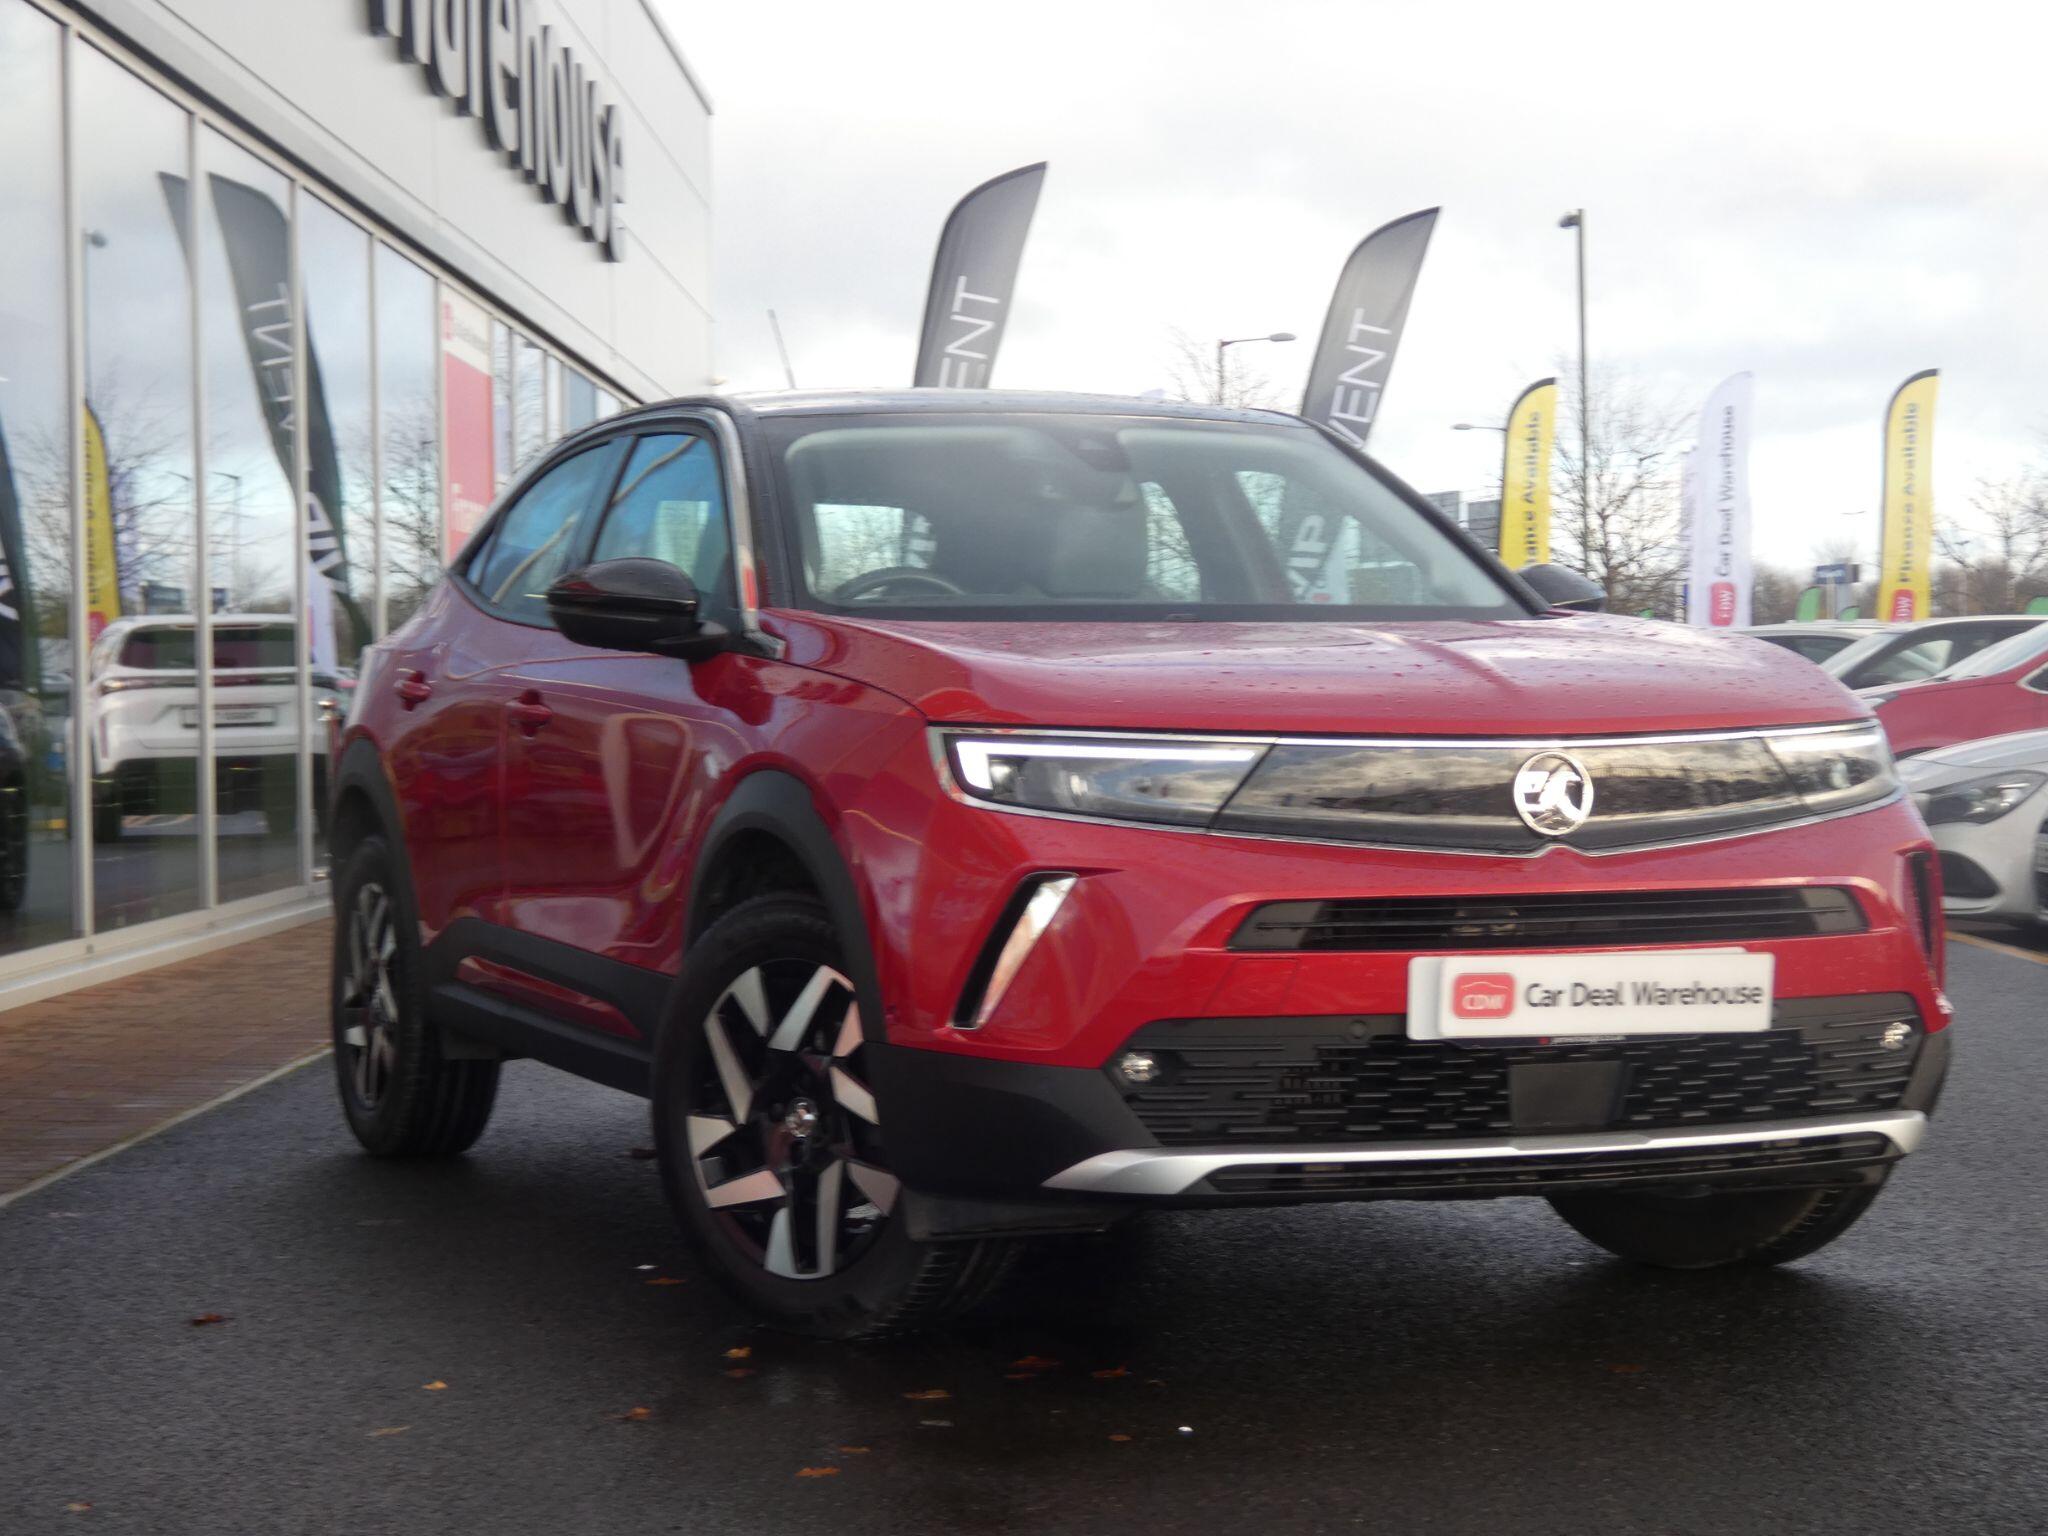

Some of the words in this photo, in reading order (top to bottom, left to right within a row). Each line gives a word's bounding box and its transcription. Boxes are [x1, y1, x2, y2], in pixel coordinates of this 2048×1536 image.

[366, 0, 626, 263] arehouse
[1522, 411, 1541, 504] Available
[1718, 405, 1735, 503] Warehouse
[1902, 403, 1919, 496] Available
[1716, 551, 1732, 577] Car
[1718, 509, 1734, 546] Deal
[1899, 503, 1914, 583] Finance
[1525, 982, 1563, 1008] Car
[1570, 981, 1623, 1008] Deal
[1631, 980, 1764, 1007] Warehouse
